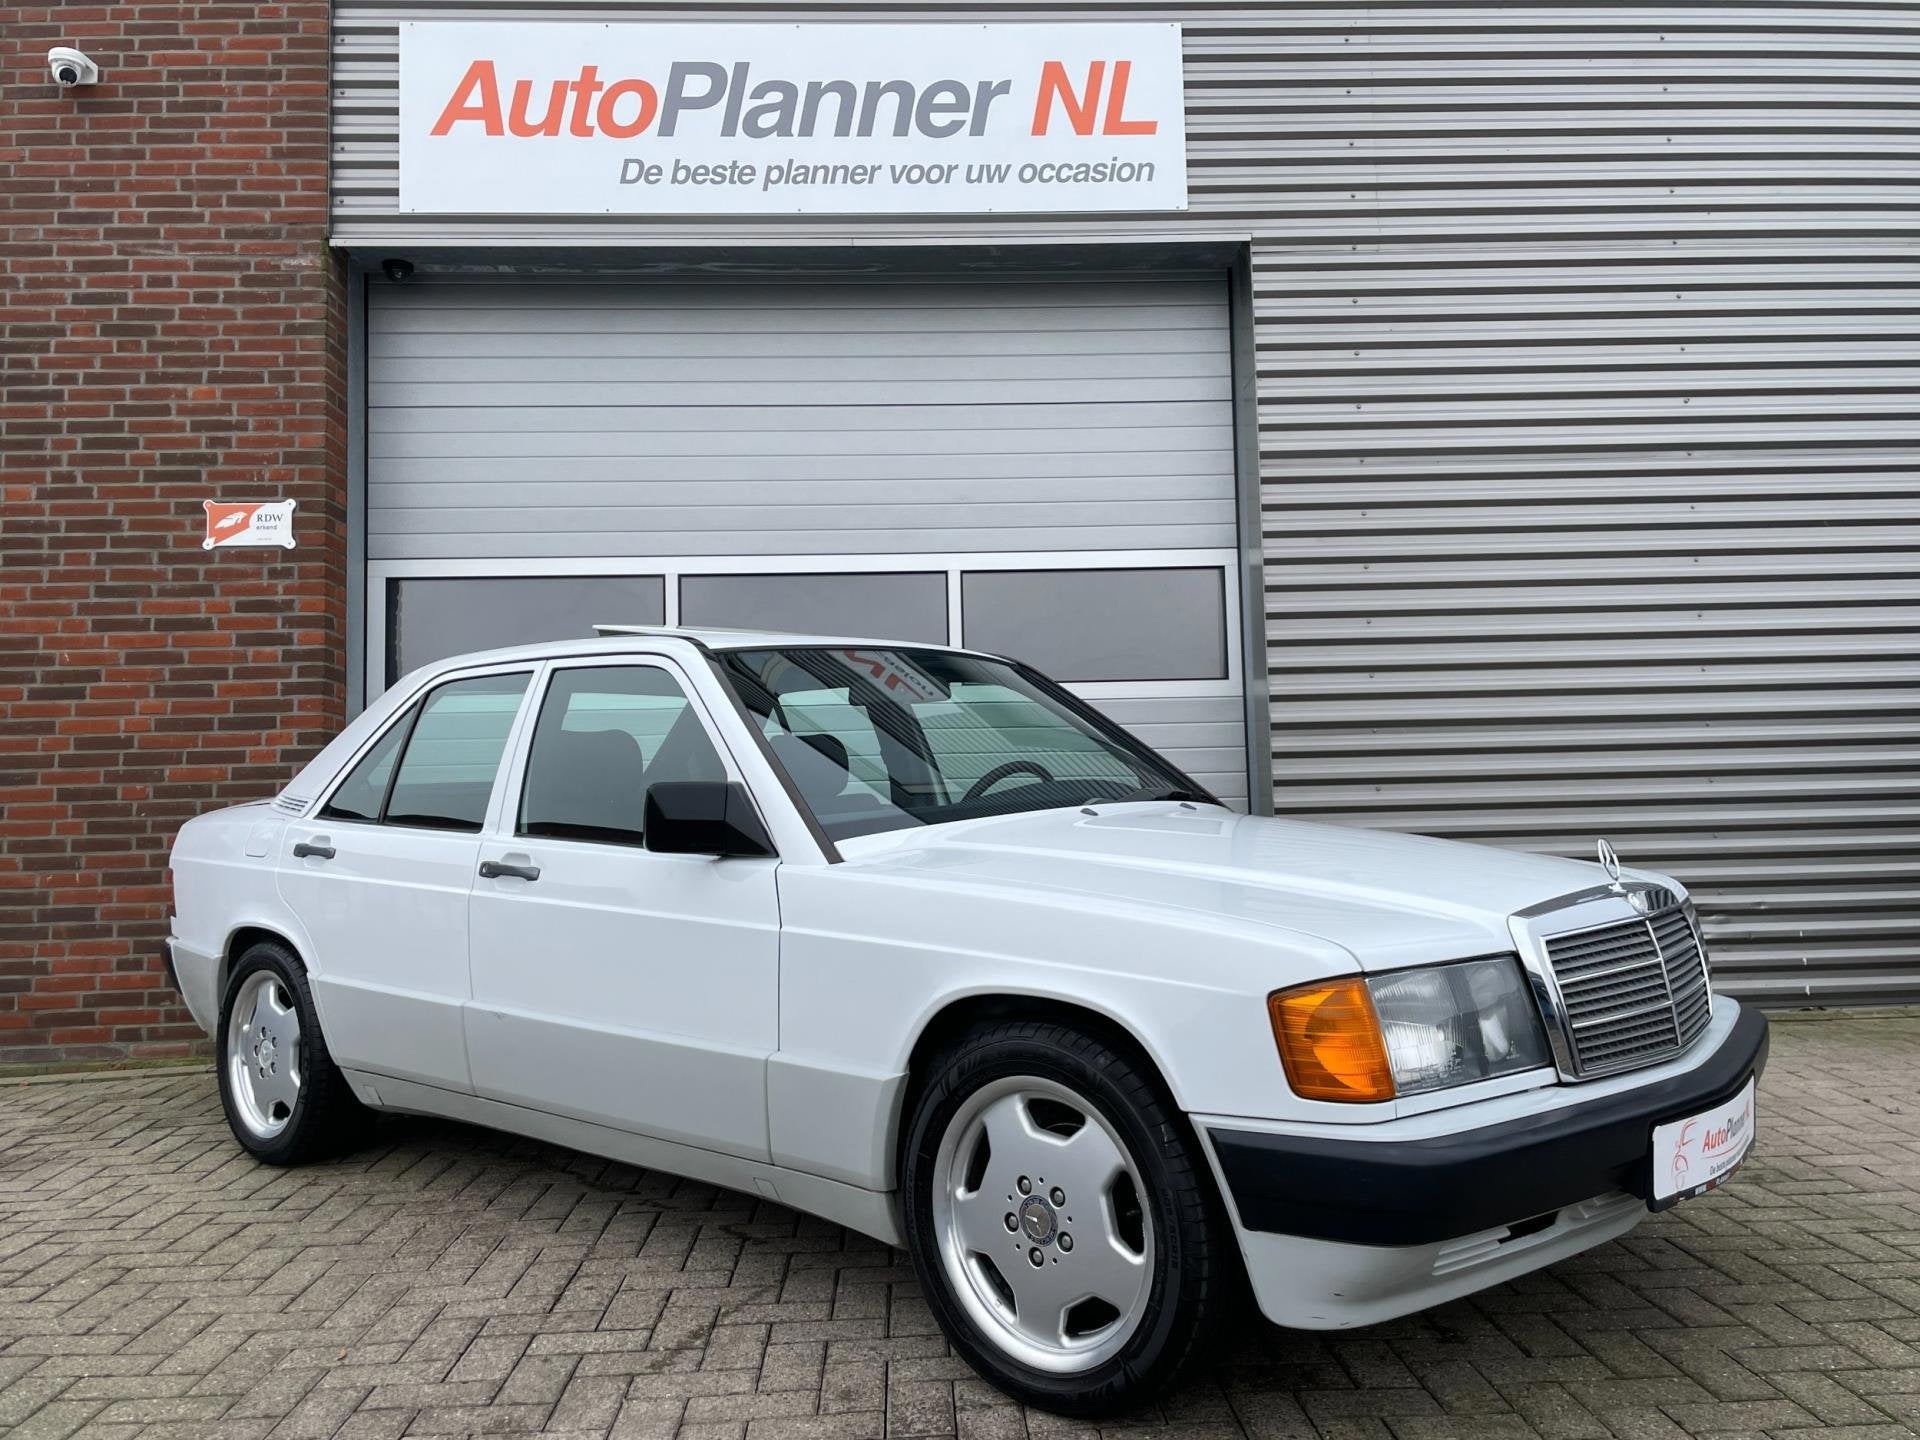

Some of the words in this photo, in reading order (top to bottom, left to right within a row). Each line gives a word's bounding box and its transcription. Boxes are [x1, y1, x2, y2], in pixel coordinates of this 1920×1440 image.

[430, 60, 1011, 138] AutoPlanner
[1031, 61, 1157, 136] NL
[620, 159, 663, 184] De
[671, 159, 756, 184] beste
[763, 159, 882, 191] planner
[890, 164, 959, 184] voor
[966, 164, 1011, 183] uw
[1018, 157, 1155, 184] occasion
[256, 513, 283, 522] RDW
